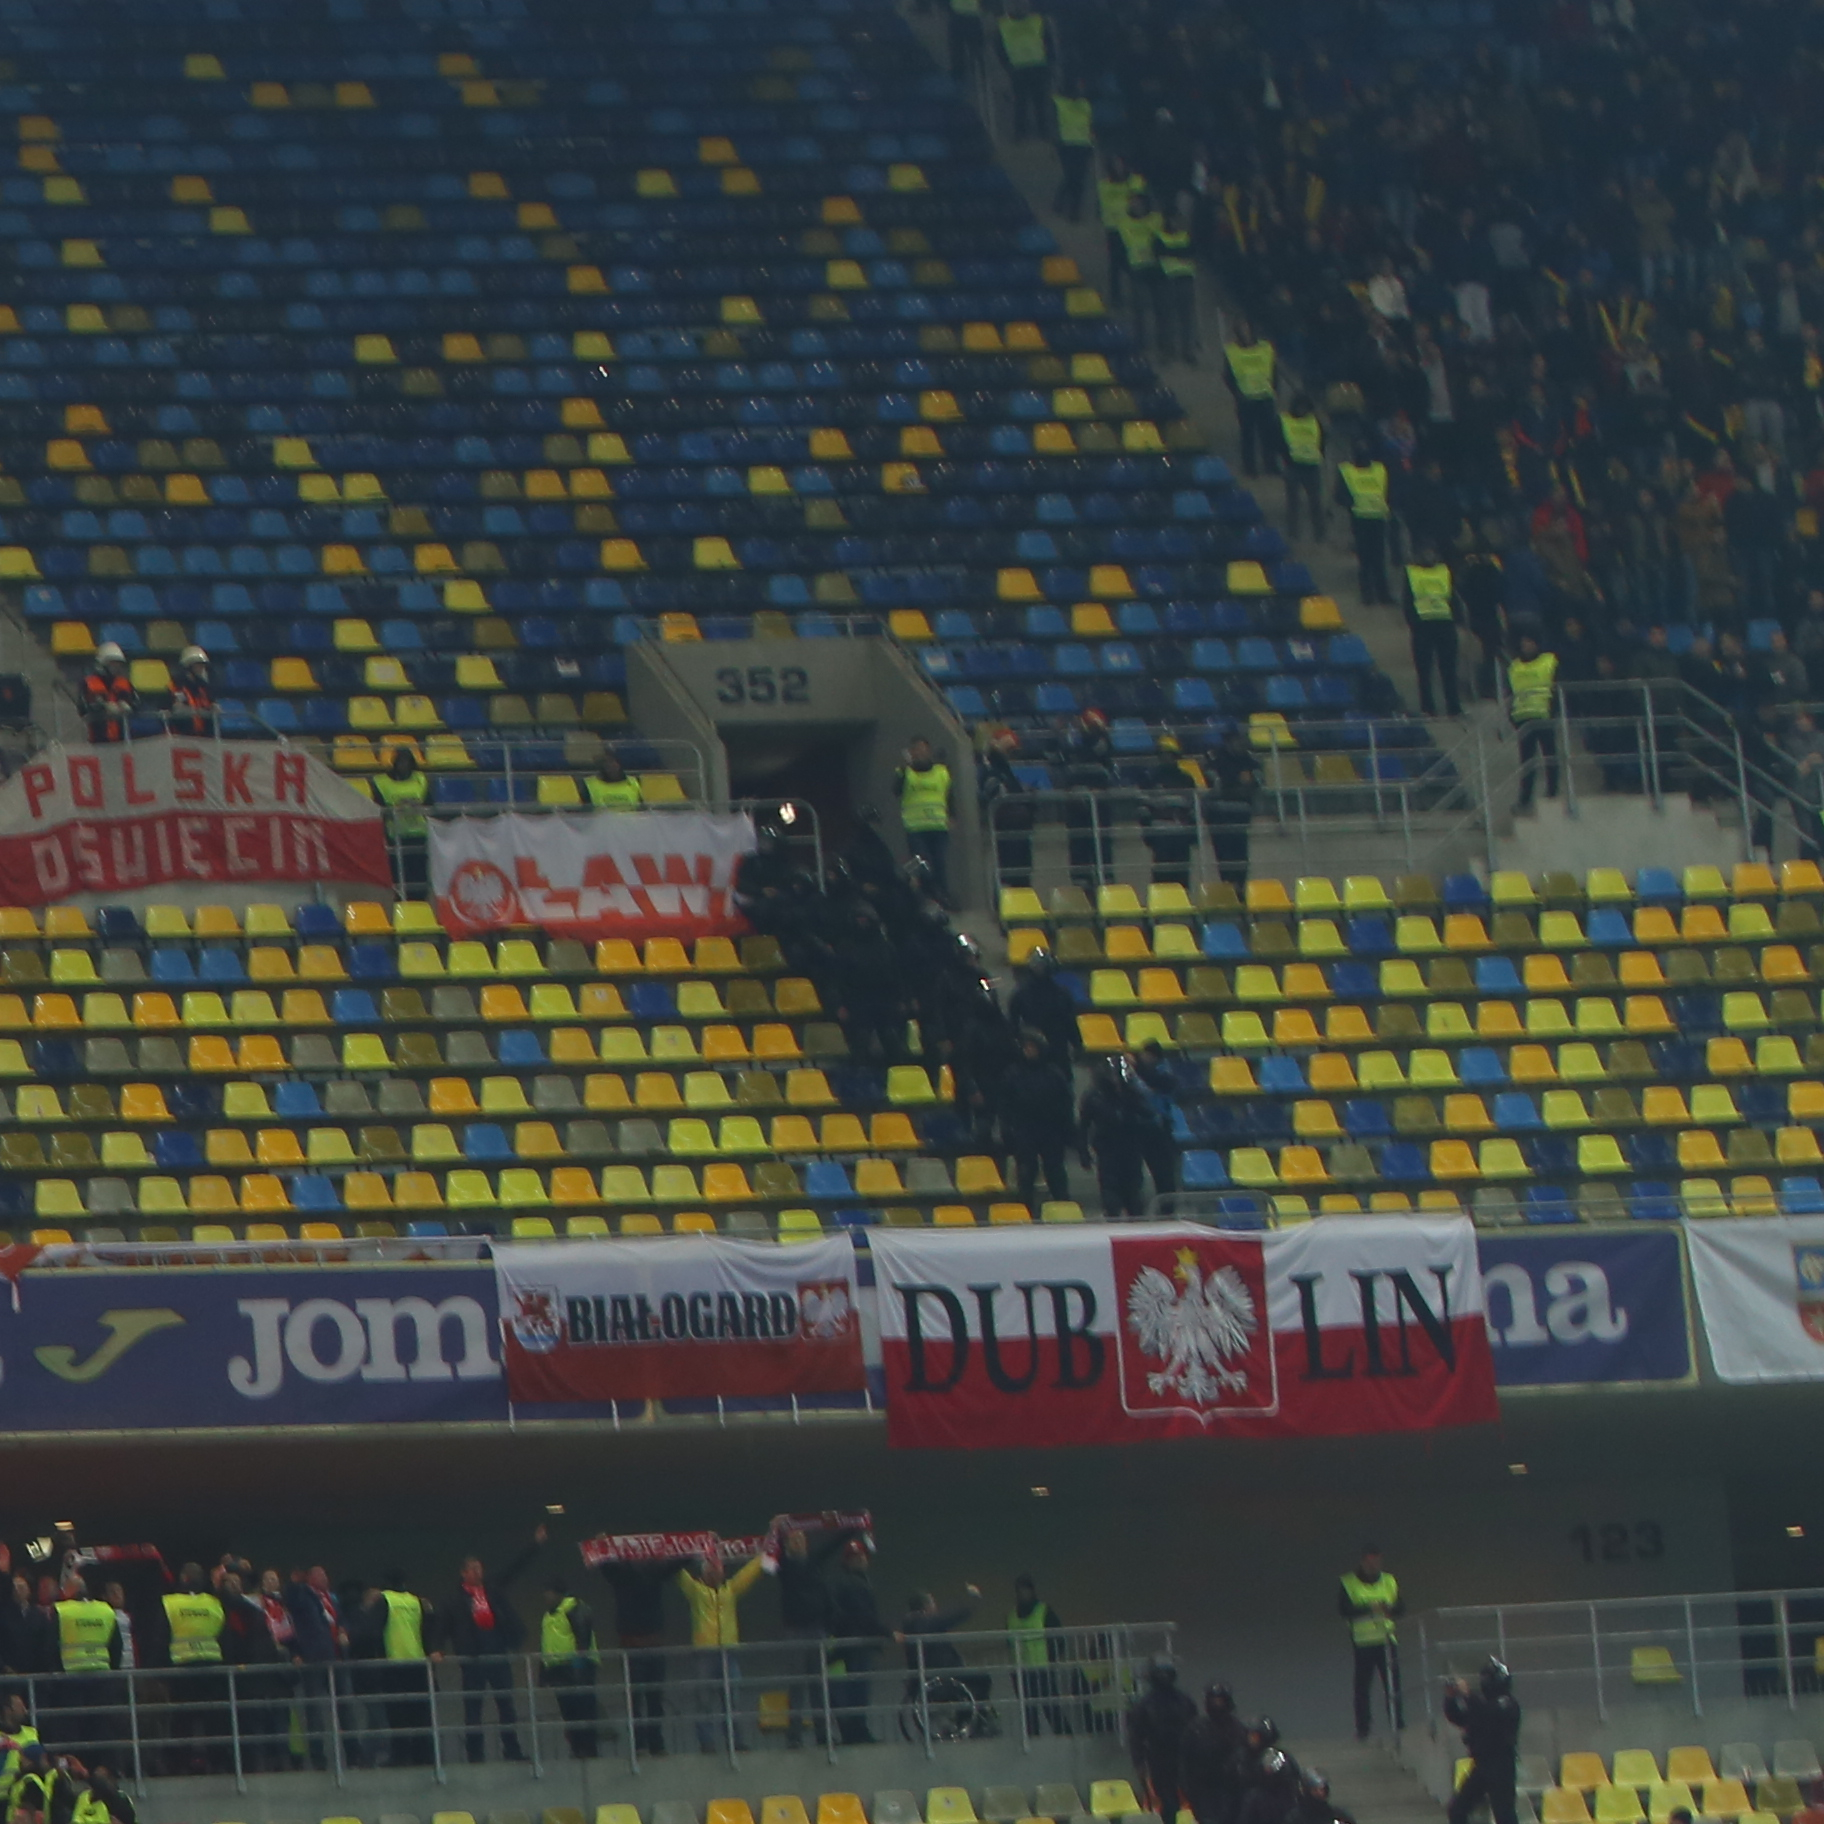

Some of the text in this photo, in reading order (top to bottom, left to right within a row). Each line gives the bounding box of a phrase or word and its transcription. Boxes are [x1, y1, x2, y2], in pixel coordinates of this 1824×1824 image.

[713, 663, 812, 707] 352
[20, 745, 310, 820] POLSKA
[32, 812, 334, 889] OŚWIĘCIM
[227, 1294, 502, 1398] Jom
[568, 1291, 798, 1343] BIAŁOGARD
[892, 1277, 1105, 1395] DUB
[1289, 1264, 1457, 1383] LIN
[1568, 1521, 1666, 1564] 123
